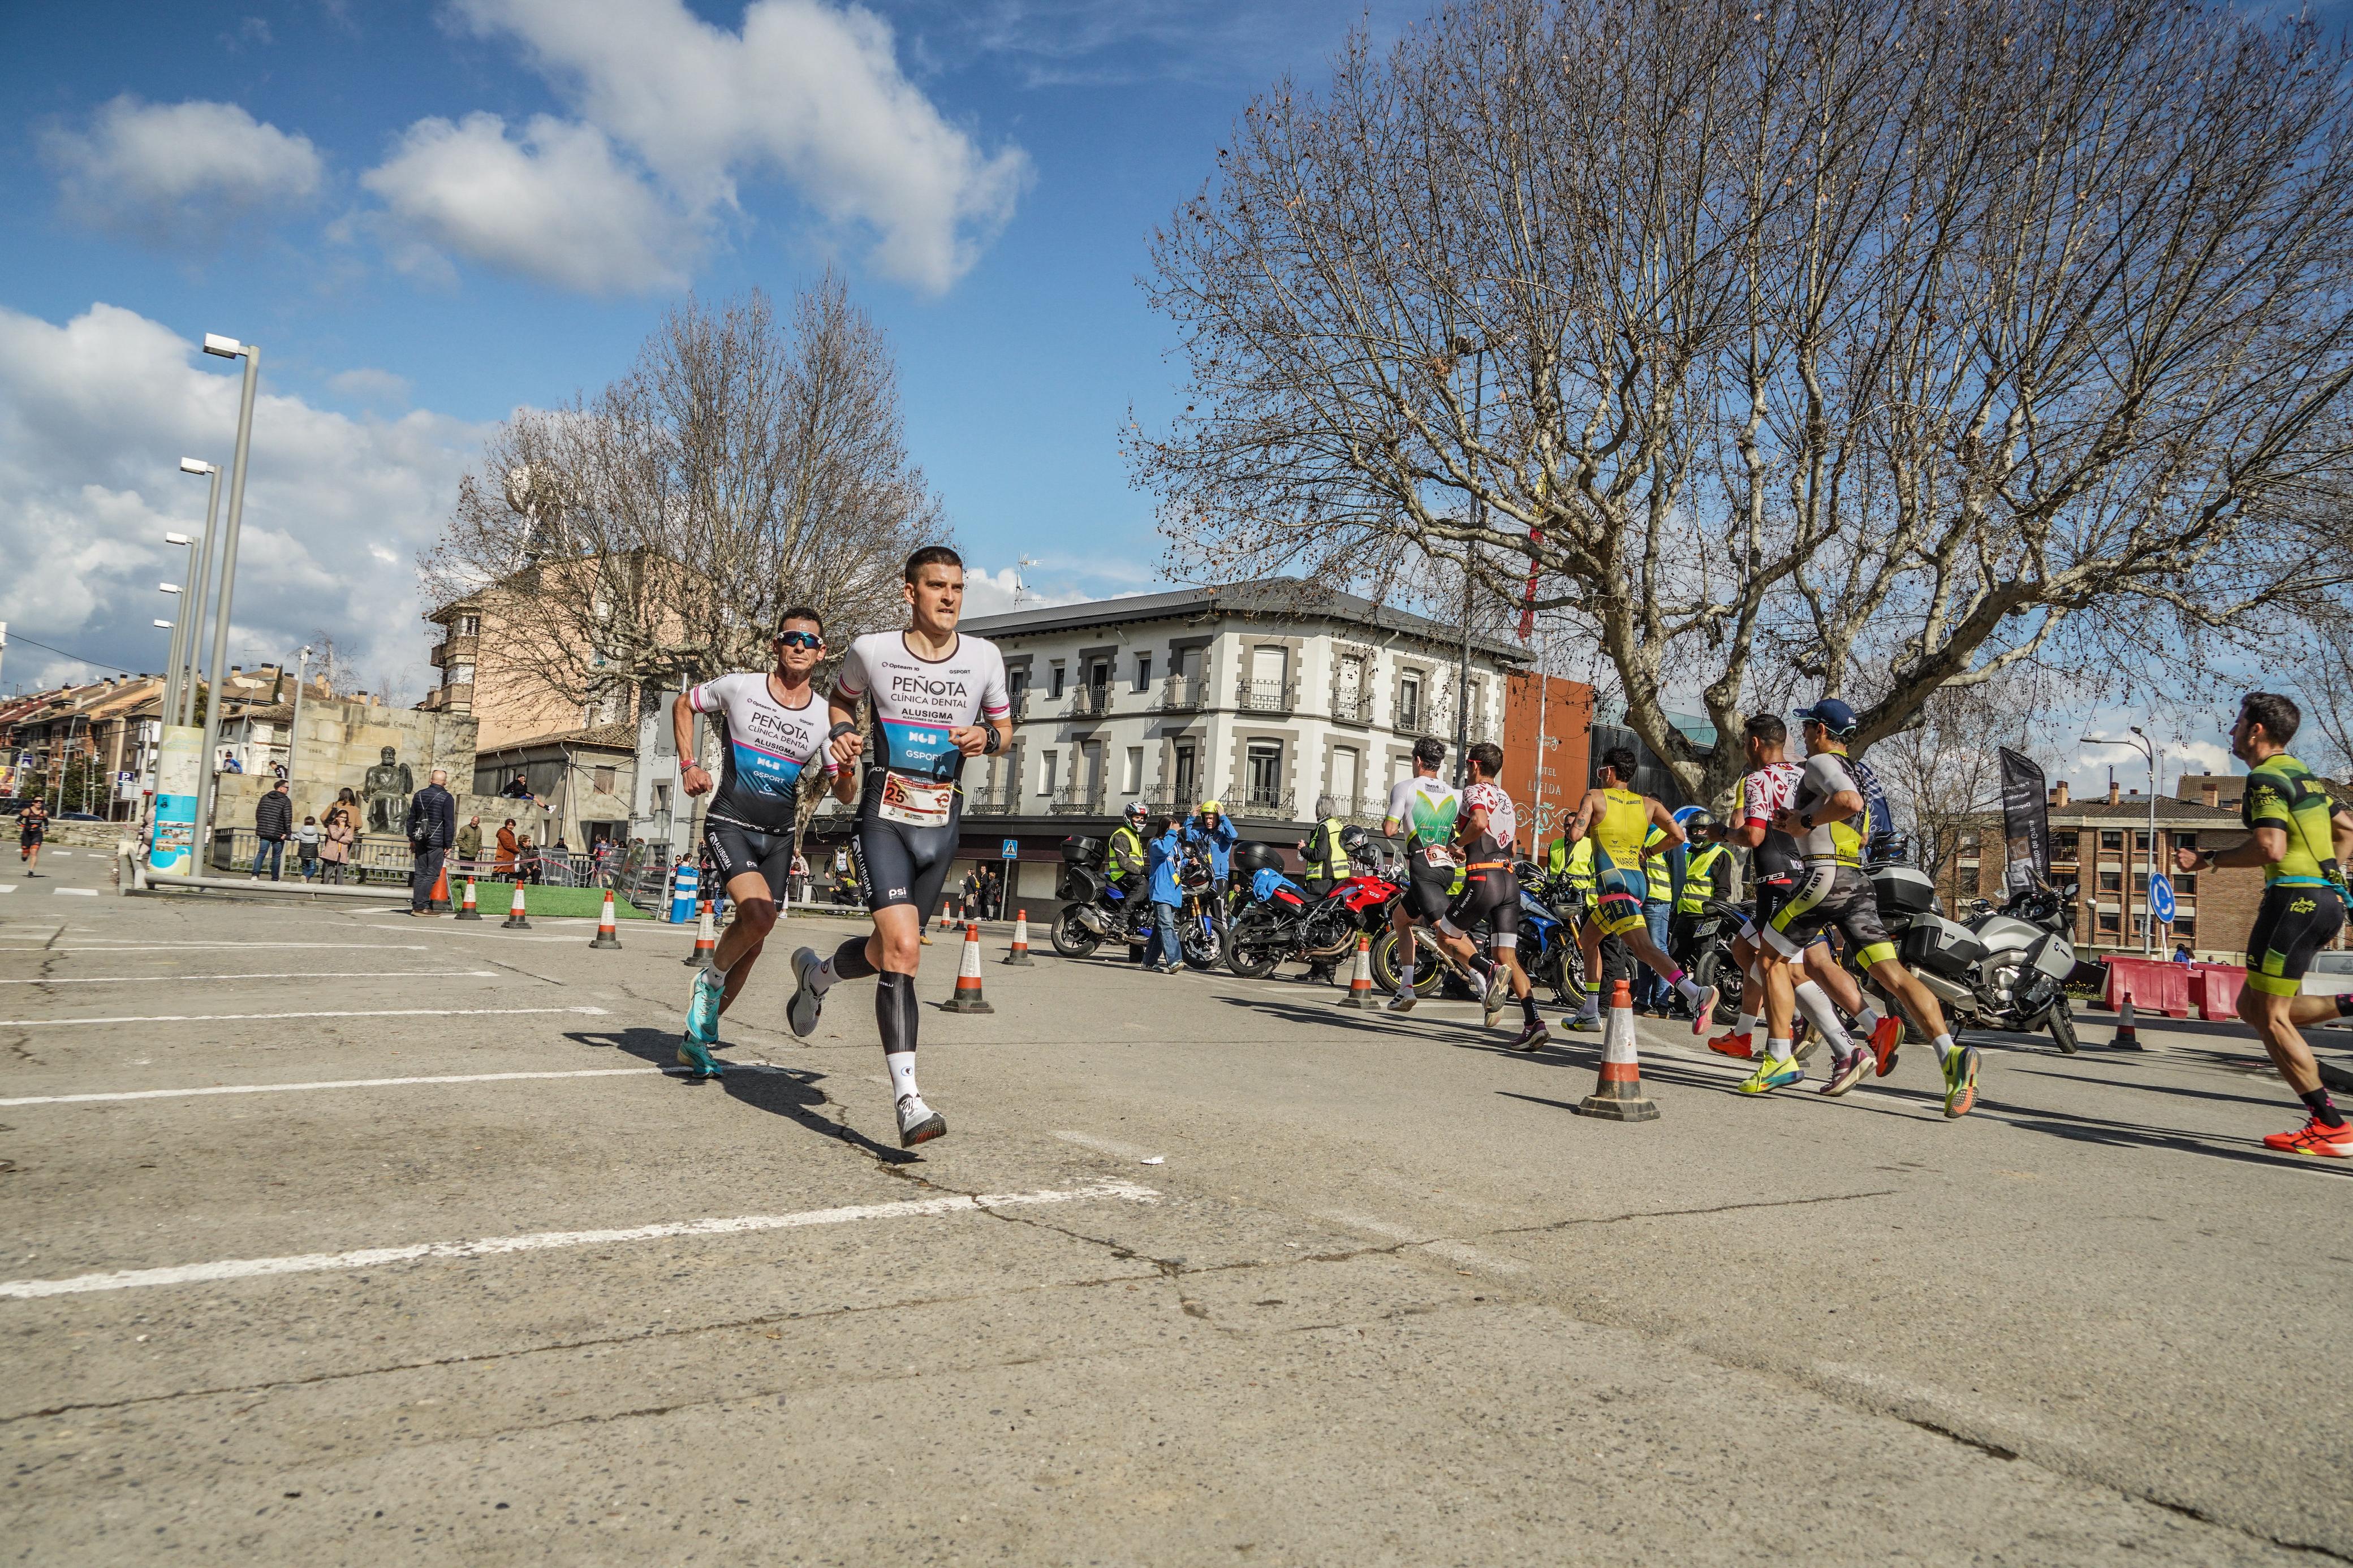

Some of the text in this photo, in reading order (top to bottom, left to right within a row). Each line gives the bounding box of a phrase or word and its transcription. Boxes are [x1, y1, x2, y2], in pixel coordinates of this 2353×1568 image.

[892, 675, 967, 697] PEÑOTA
[753, 701, 771, 710] Opteam
[891, 693, 967, 708] CLÍNICA DENTAL
[901, 708, 953, 720] ALUSIGMA
[751, 712, 809, 743] PEÑOTA
[748, 725, 808, 751] CLÍNICA DENTAL
[755, 738, 795, 756] ALUSIGMA
[906, 750, 944, 762] GSPORT
[753, 771, 785, 784] GSPORT
[885, 787, 904, 803] 25
[714, 842, 732, 870] ALUSIGMA
[857, 854, 873, 898] ALUSIGMA
[889, 887, 907, 899] psi
[1800, 872, 1824, 901] TRI 401
[1460, 888, 1473, 908] INFINITY
